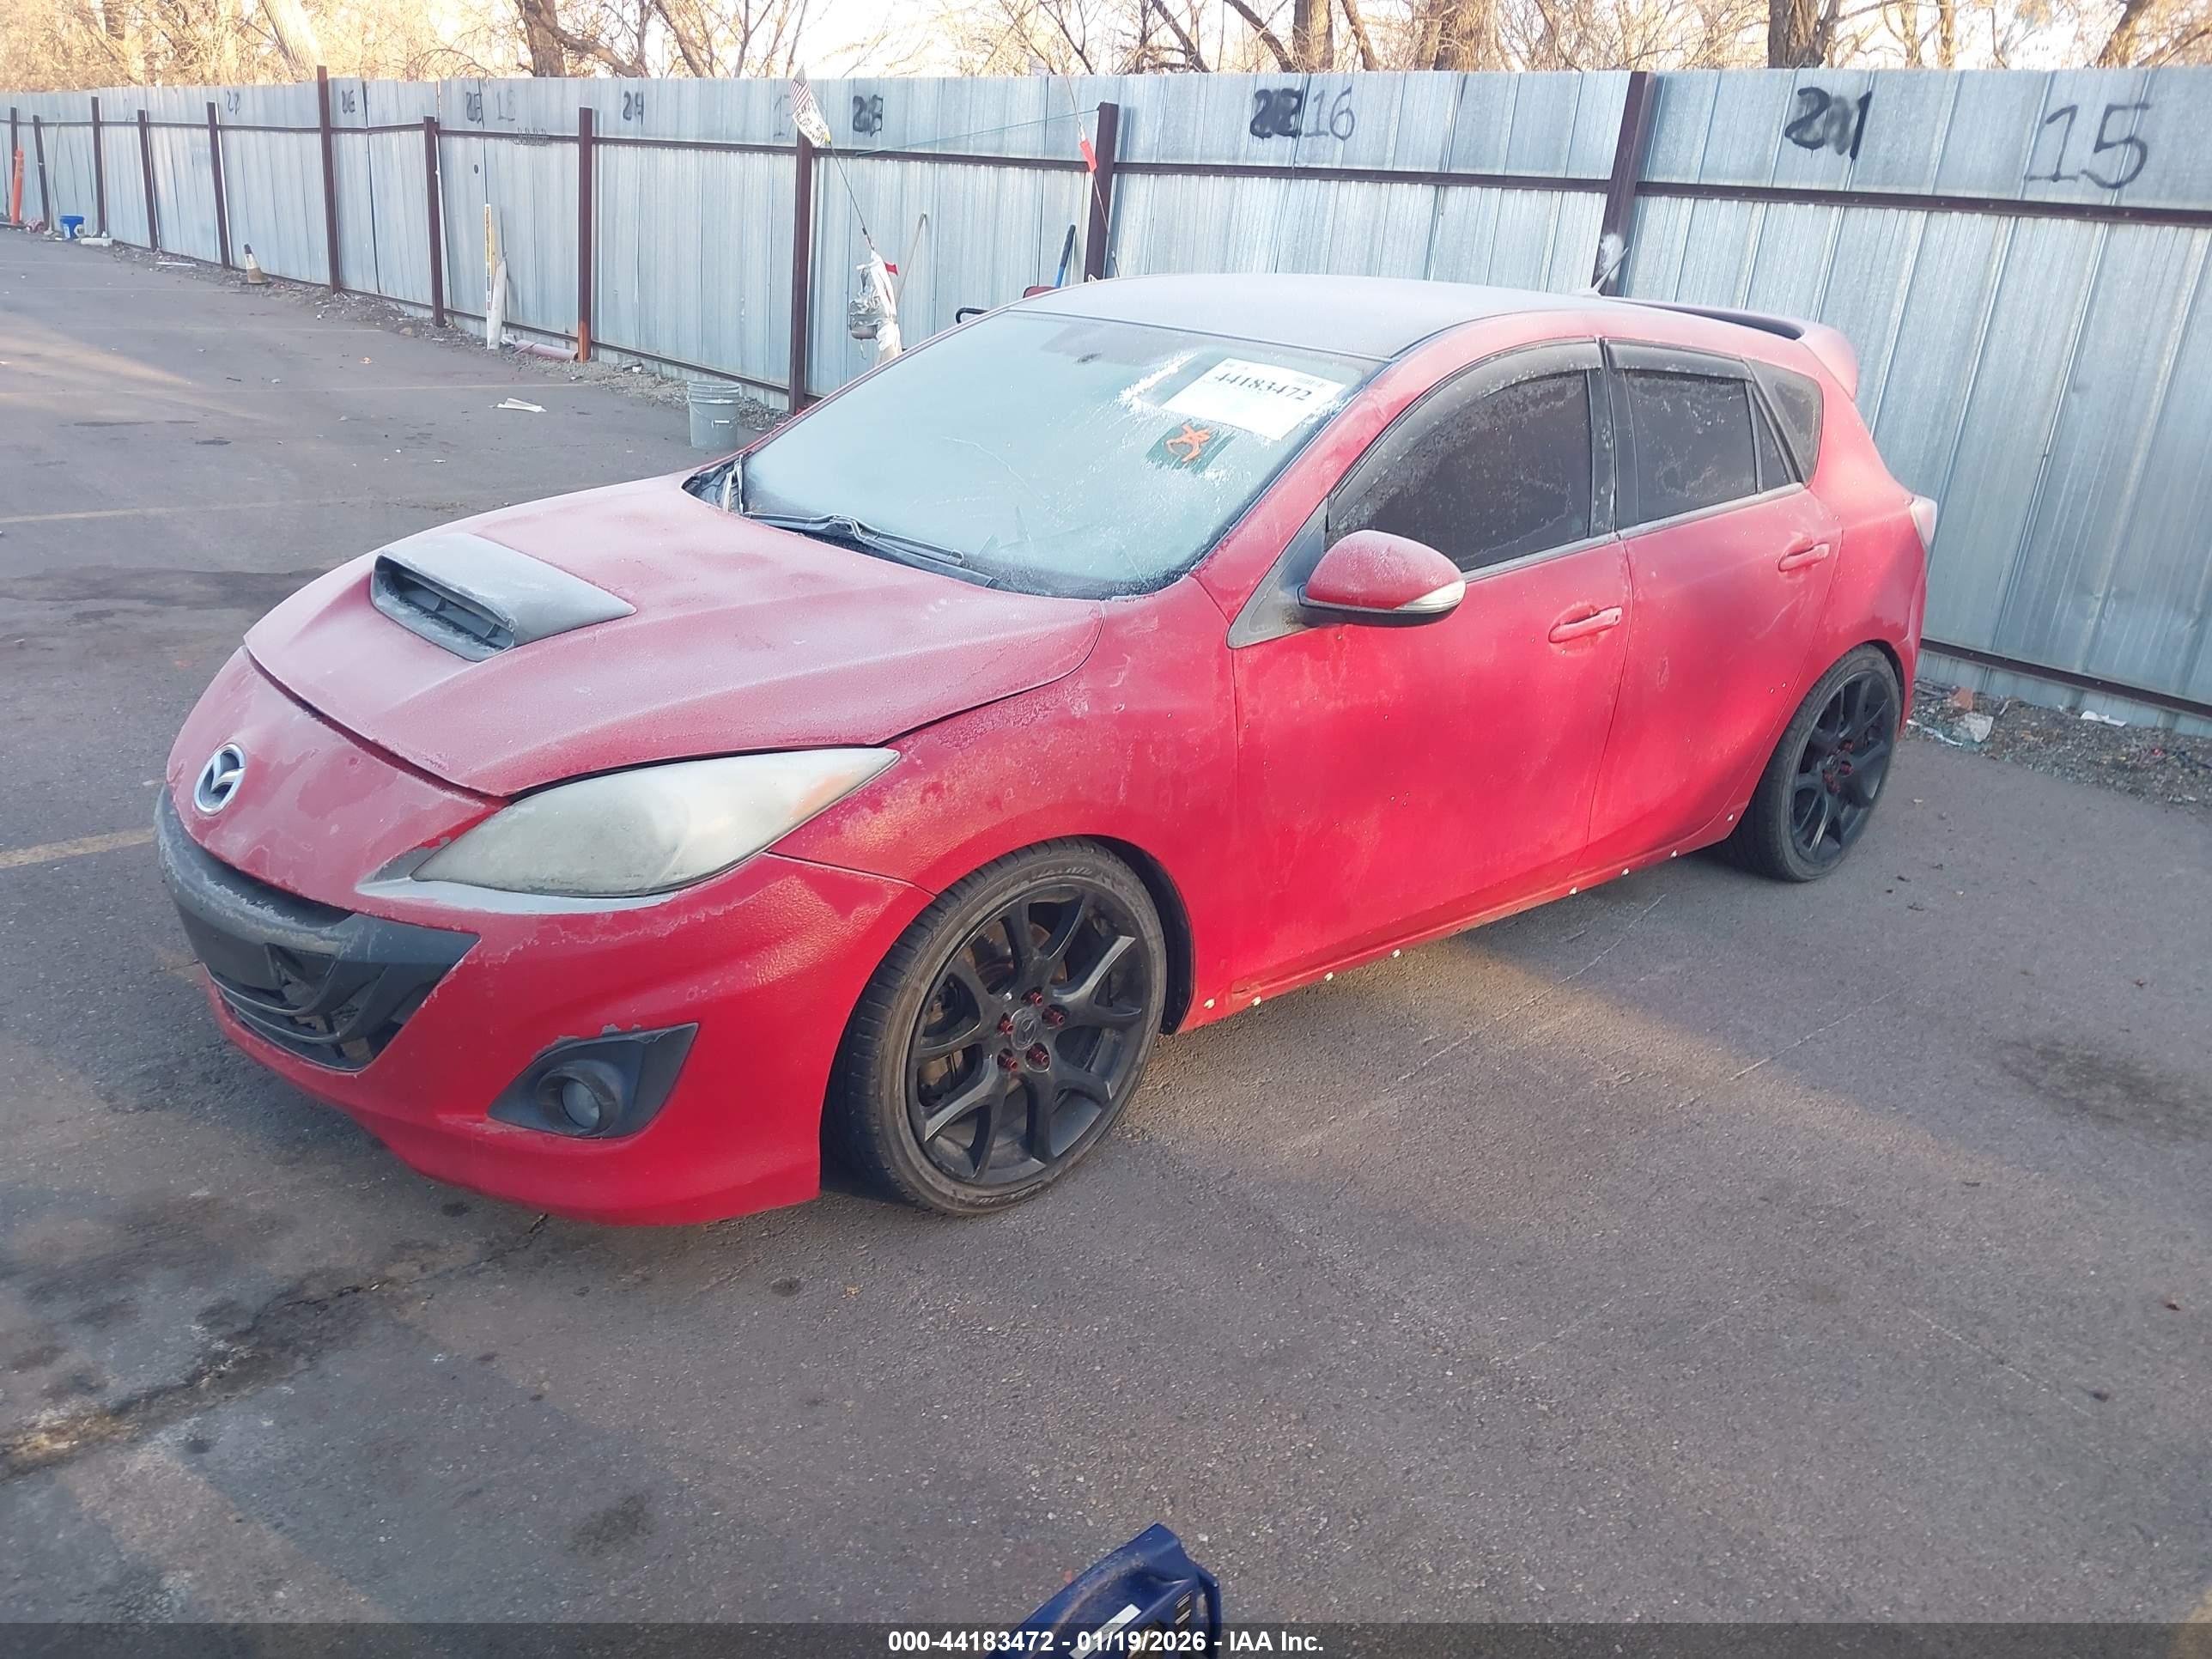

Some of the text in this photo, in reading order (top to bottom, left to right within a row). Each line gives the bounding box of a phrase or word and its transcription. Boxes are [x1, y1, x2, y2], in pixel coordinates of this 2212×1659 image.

[1304, 86, 1355, 140] 16
[2024, 101, 2152, 190] 15
[1214, 372, 1313, 402] 44183472
